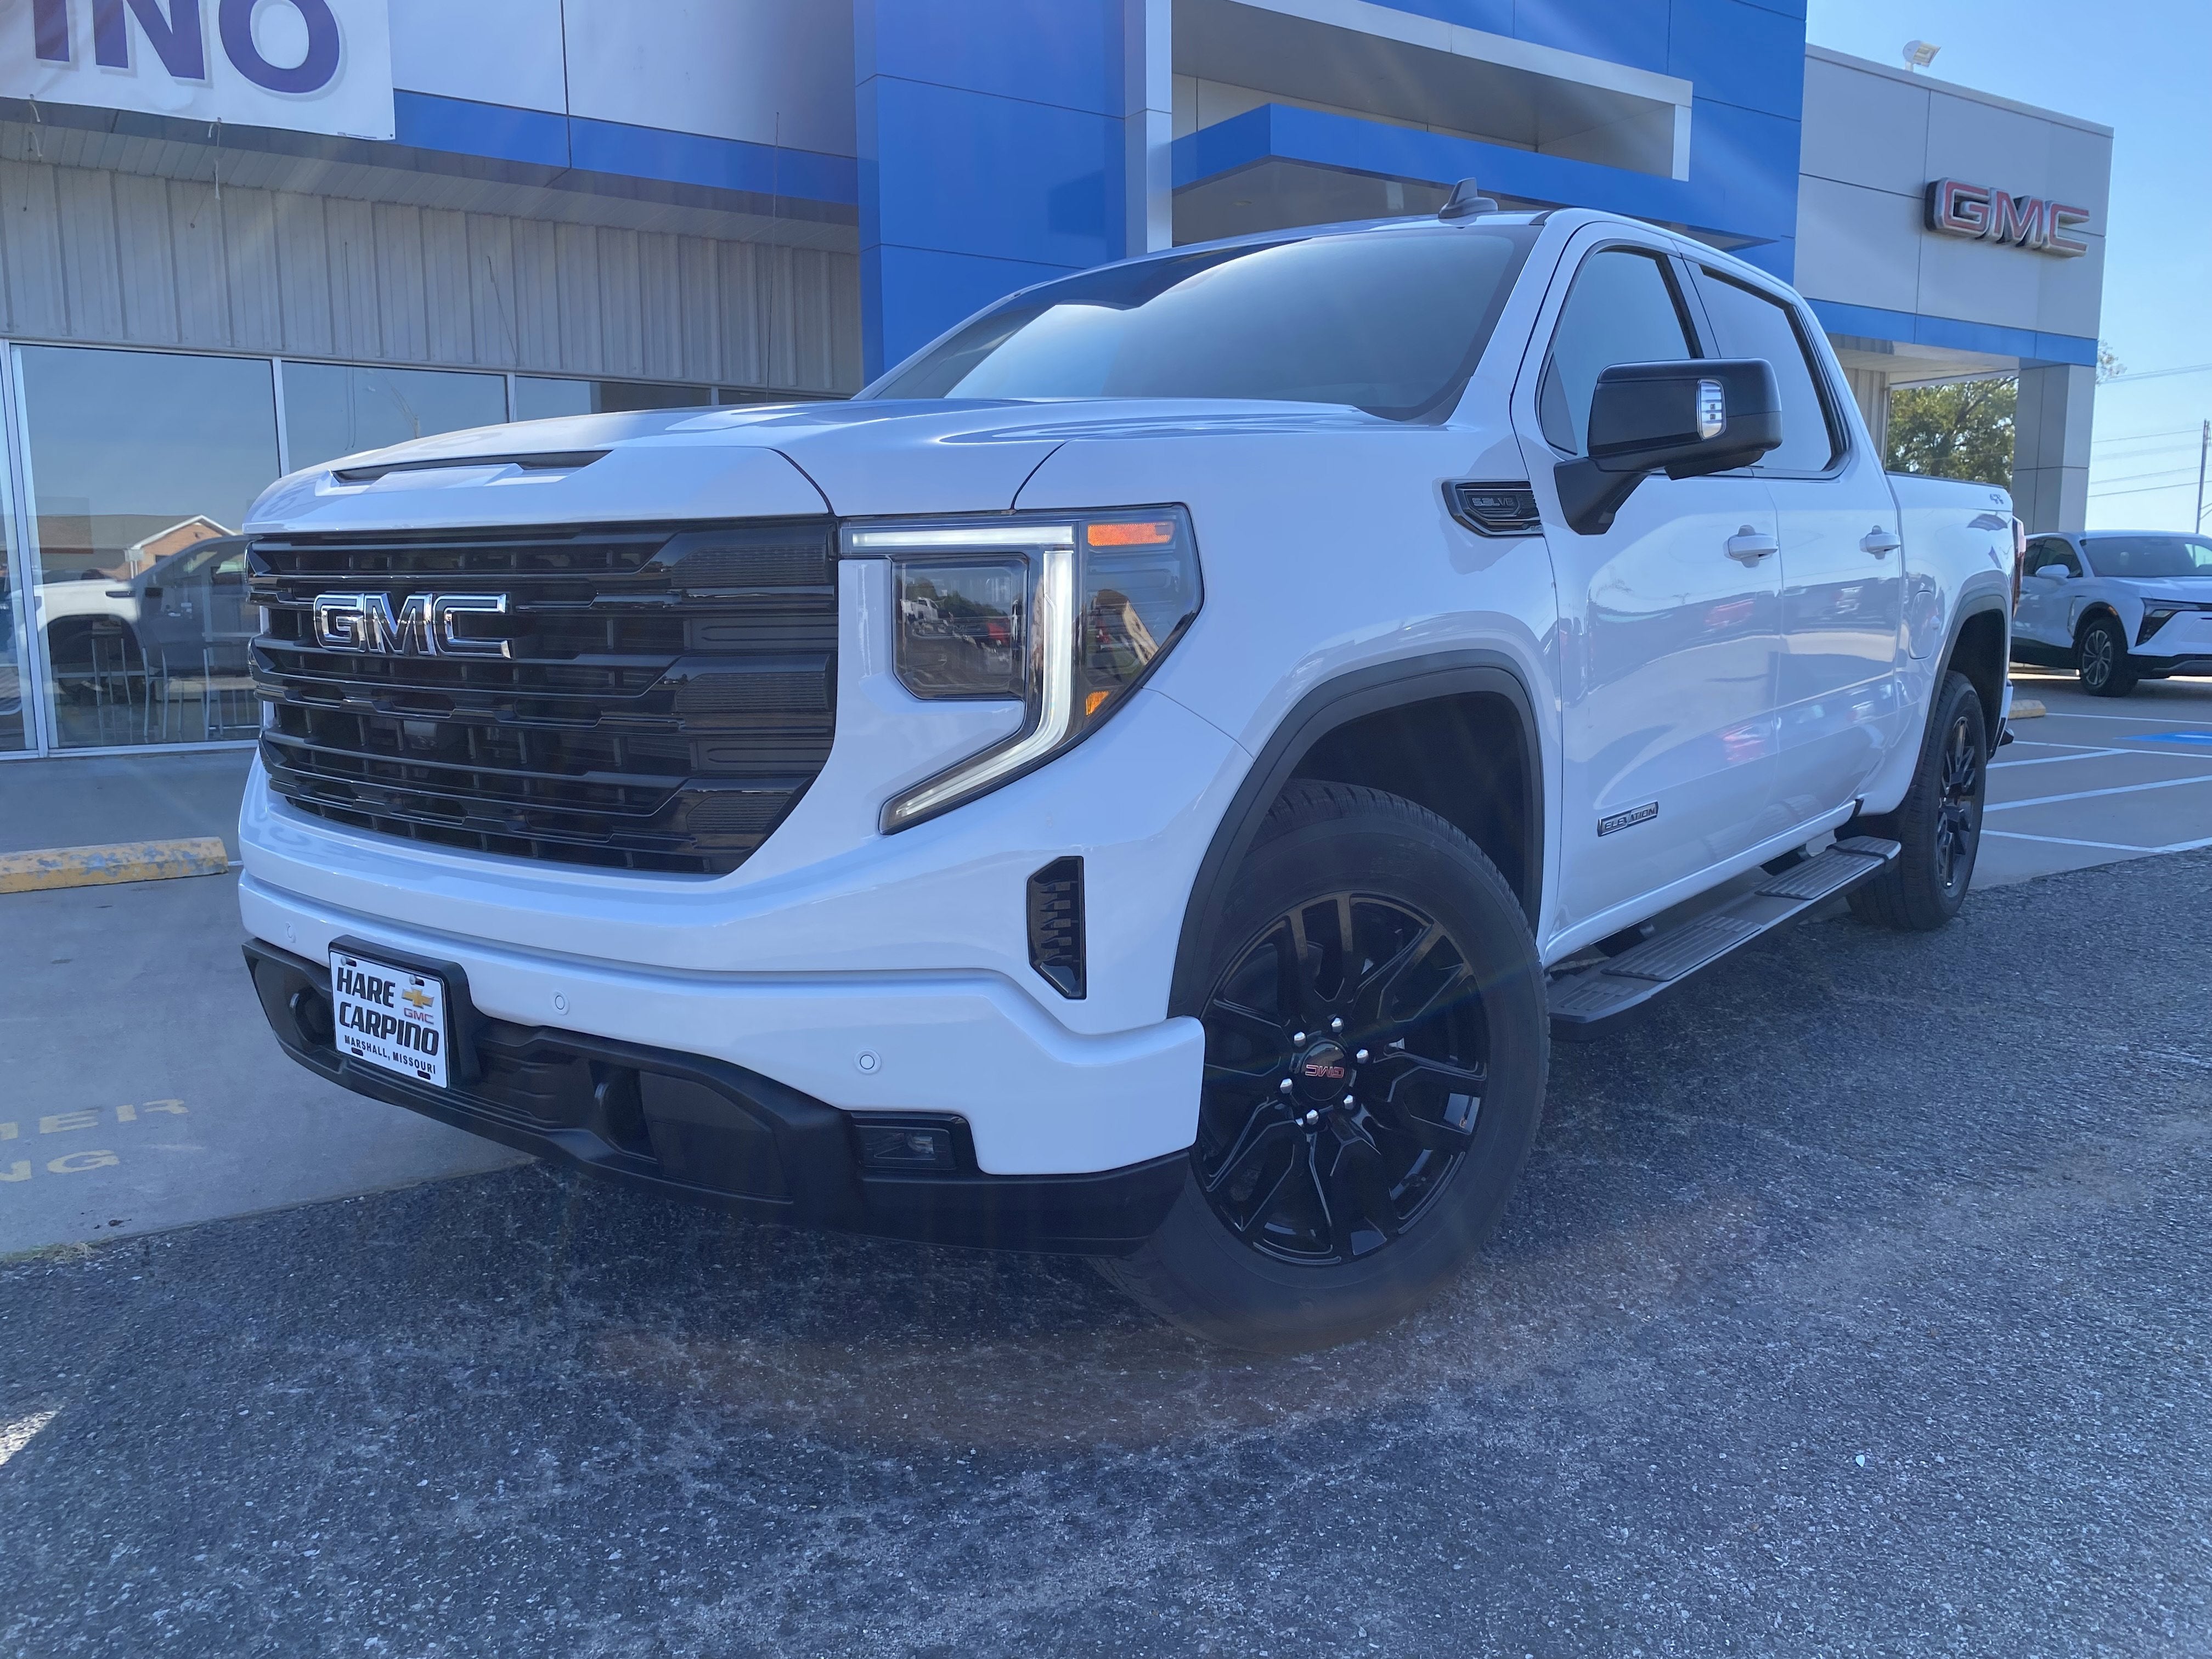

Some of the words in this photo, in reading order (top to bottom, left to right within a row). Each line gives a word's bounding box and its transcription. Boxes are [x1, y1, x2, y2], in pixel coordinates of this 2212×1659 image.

[33, 0, 340, 93] INO
[1931, 177, 2090, 256] GMC
[313, 592, 511, 659] GMC
[1604, 807, 1656, 830] ELEVATION
[337, 967, 396, 1008] HARE
[339, 1001, 439, 1056] CARPINO
[404, 1008, 435, 1024] GMC
[345, 1035, 390, 1061] MARSHALL,
[392, 1051, 436, 1074] MISSOURI
[1305, 1064, 1345, 1079] GMC
[0, 1099, 190, 1141] ER
